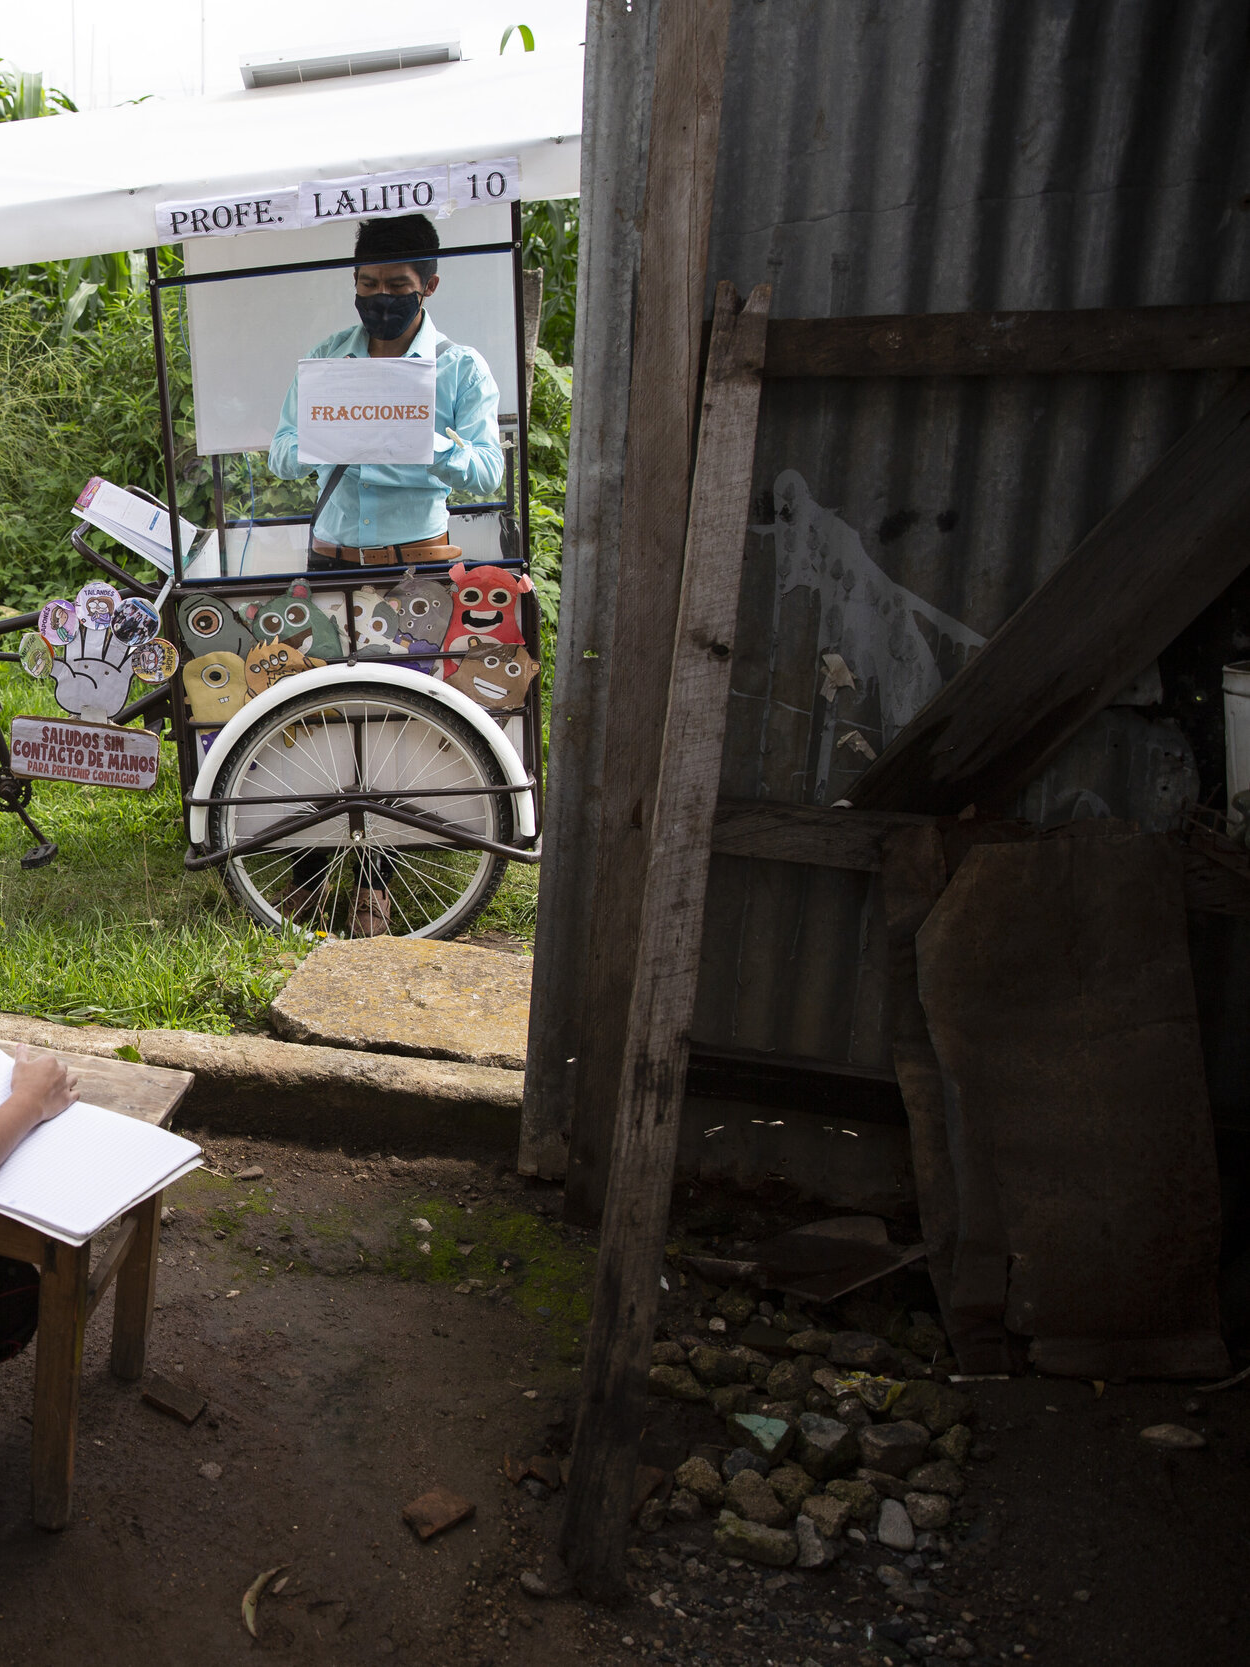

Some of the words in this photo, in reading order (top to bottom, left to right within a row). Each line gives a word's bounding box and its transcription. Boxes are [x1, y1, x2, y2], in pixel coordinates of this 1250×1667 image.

[170, 199, 284, 235] PROFE.
[312, 181, 435, 219] LALITO
[467, 171, 506, 200] 10
[311, 405, 430, 422] FRACCIONES
[42, 726, 100, 750] SALUDOS
[104, 733, 125, 753] SIN
[13, 739, 85, 766] CONTACTO
[88, 750, 104, 769] DE
[108, 753, 156, 774] MANOS
[27, 760, 50, 775] PARA
[51, 765, 90, 780] PREVENIR
[92, 769, 139, 785] CONTAGIOS
